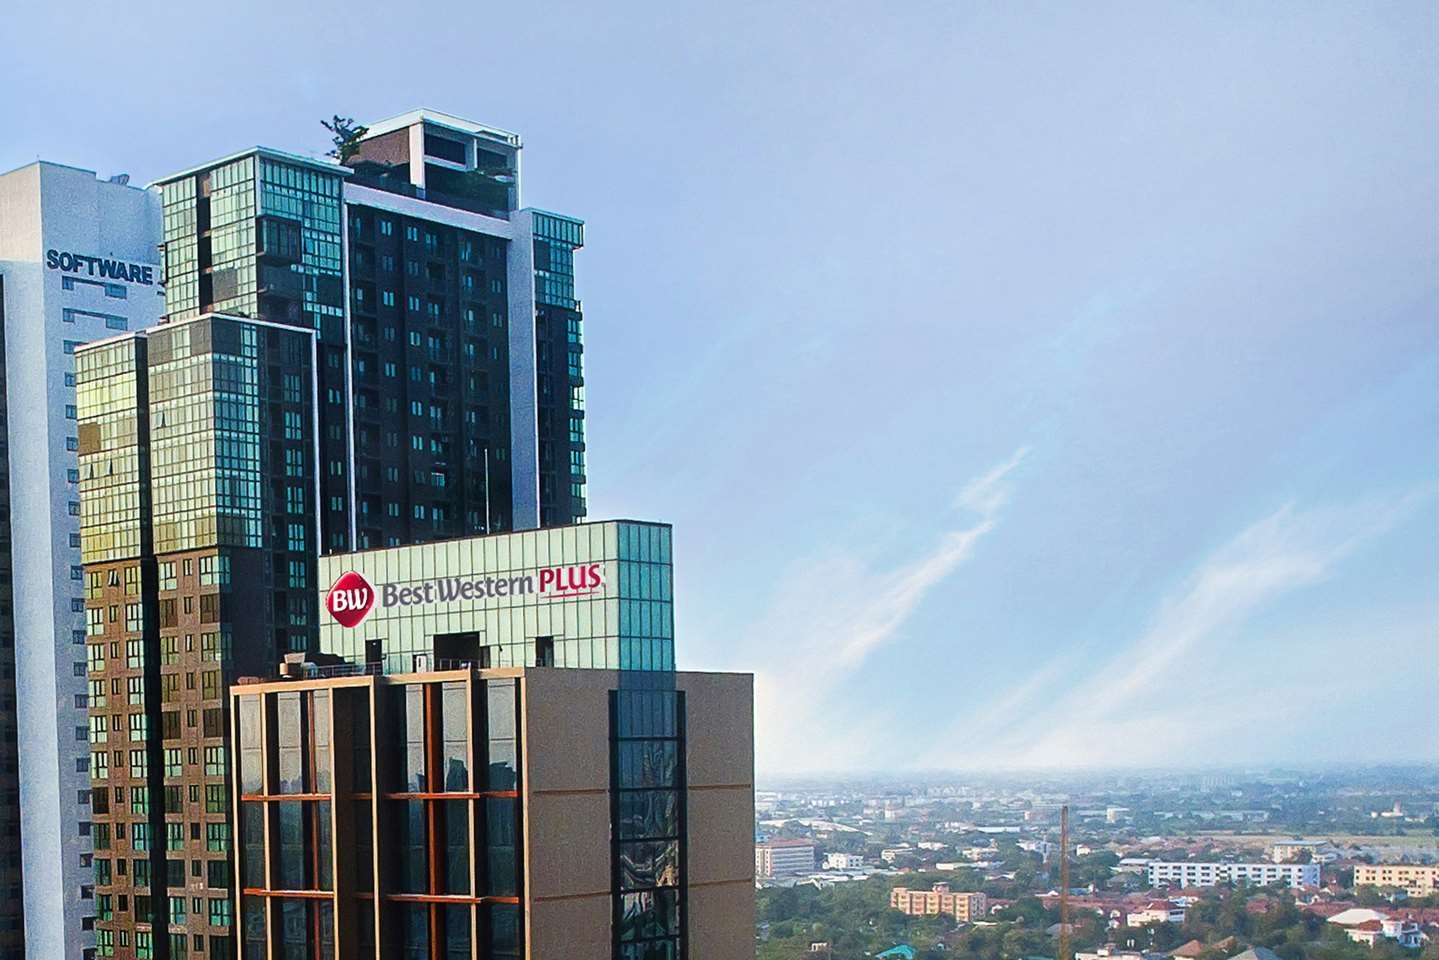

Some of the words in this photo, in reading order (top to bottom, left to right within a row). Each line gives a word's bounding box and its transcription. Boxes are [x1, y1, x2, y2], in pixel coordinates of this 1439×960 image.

[46, 249, 153, 286] SOFTWARE
[332, 586, 369, 610] BW
[382, 582, 434, 607] Best
[438, 576, 534, 603] Western
[539, 563, 601, 593] PLUS
